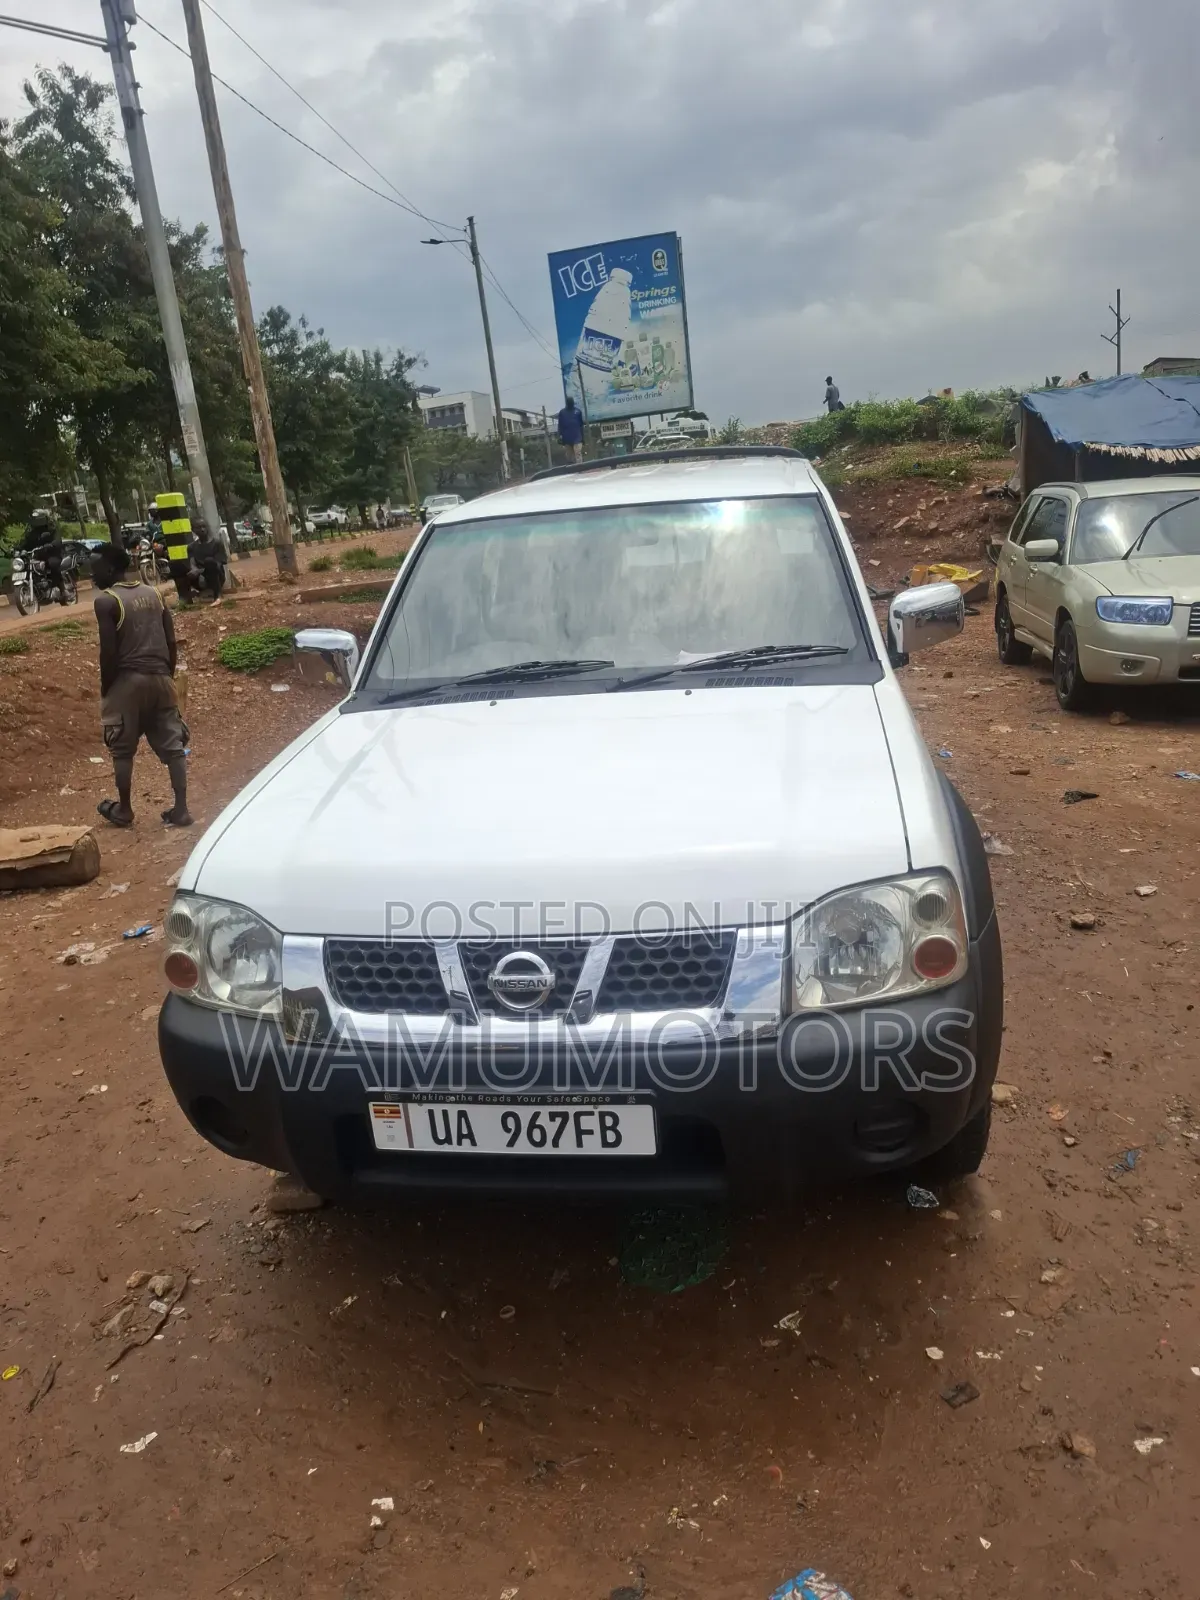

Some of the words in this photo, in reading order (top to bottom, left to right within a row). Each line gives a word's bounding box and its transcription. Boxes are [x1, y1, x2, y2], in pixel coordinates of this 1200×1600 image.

[558, 252, 608, 298] ICE
[631, 285, 677, 301] Springs
[638, 296, 677, 309] DRINKING
[612, 393, 643, 404] Favorite
[644, 390, 663, 401] drink
[493, 979, 548, 989] NISSAN
[412, 1093, 450, 1103] Making
[456, 1093, 473, 1101] the
[478, 1094, 512, 1103] Roads
[516, 1095, 542, 1103] Your
[546, 1095, 571, 1103] Safe
[577, 1095, 611, 1105] Space
[427, 1108, 478, 1147] UA
[500, 1110, 623, 1149] 967FB
